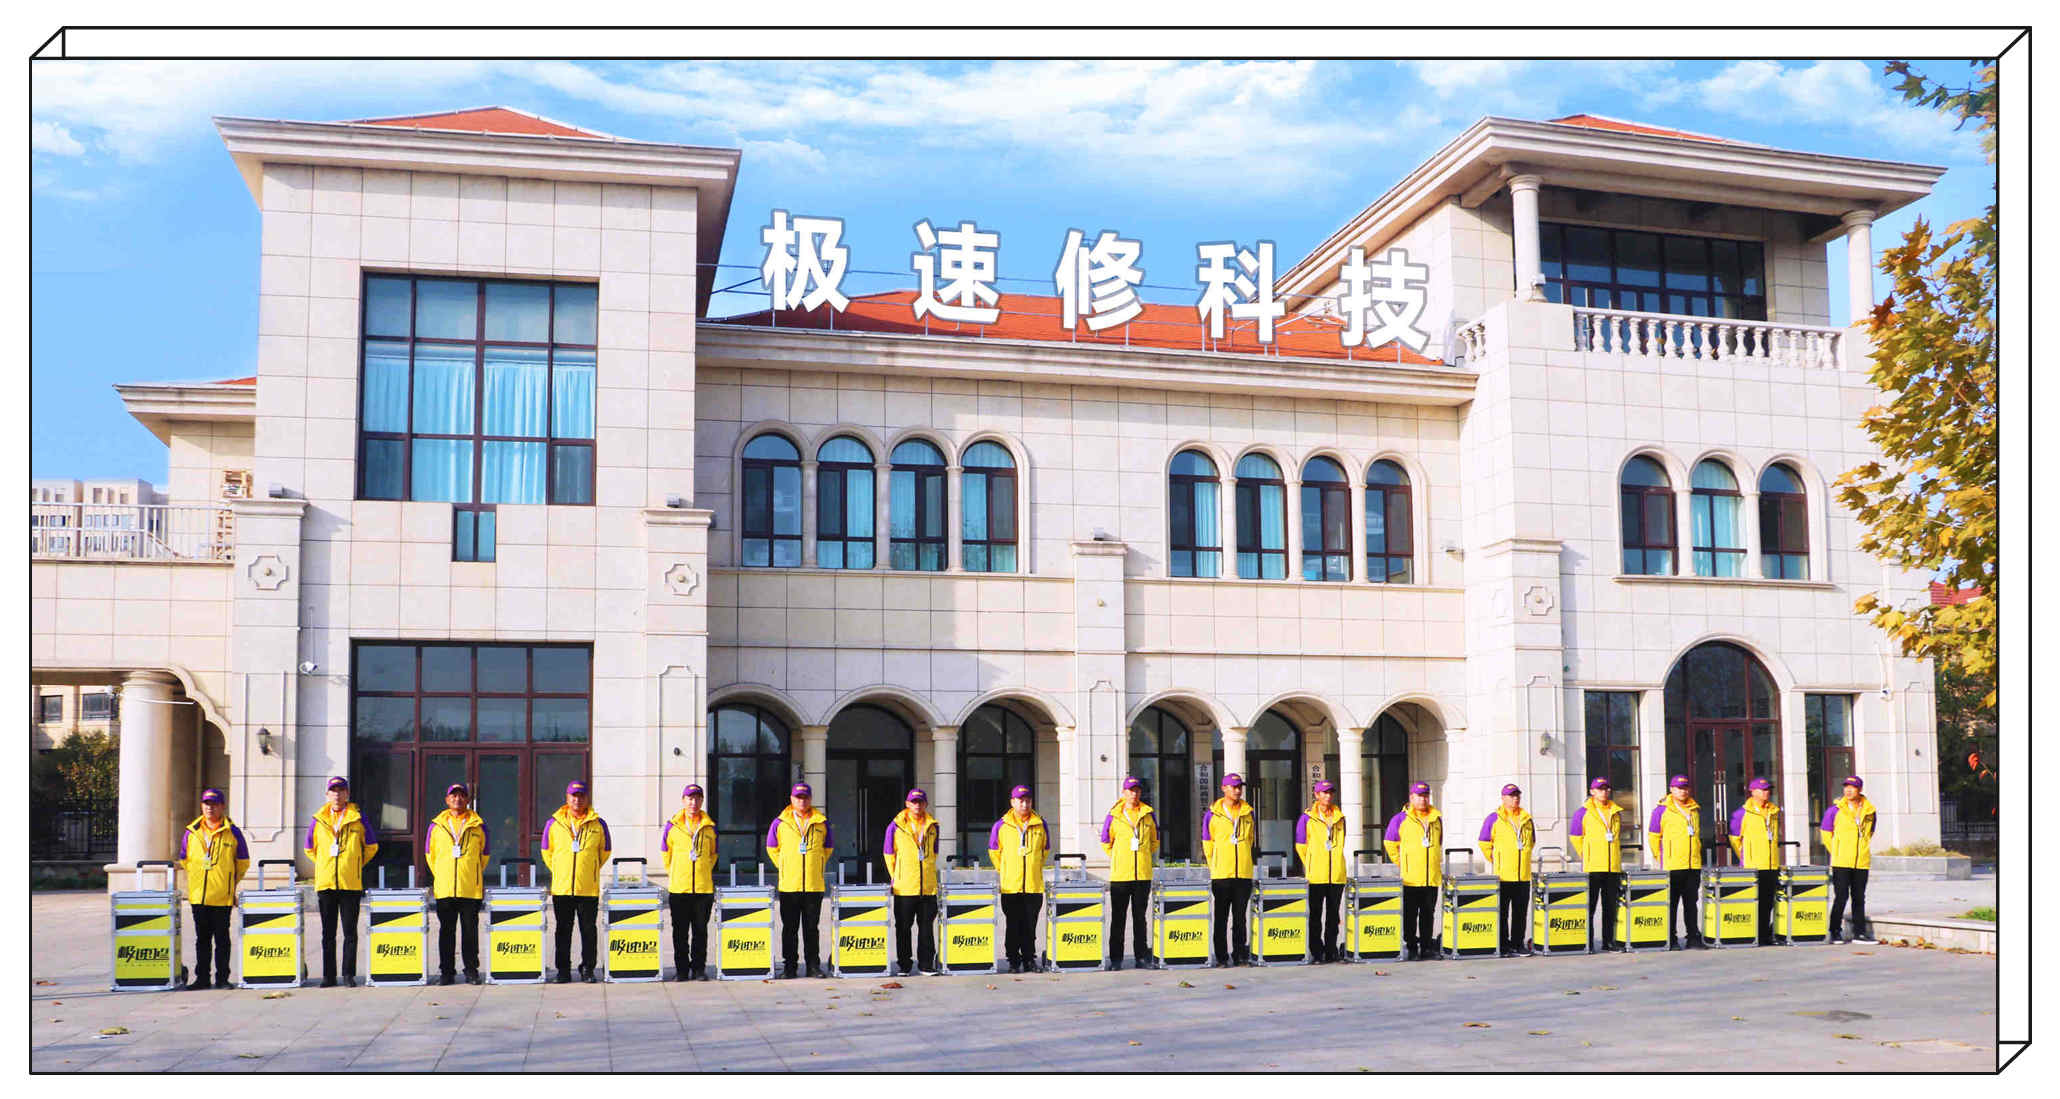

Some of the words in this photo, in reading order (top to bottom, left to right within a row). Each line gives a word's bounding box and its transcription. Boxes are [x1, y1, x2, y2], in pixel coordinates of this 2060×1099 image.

[760, 208, 1431, 354] 极速修科技
